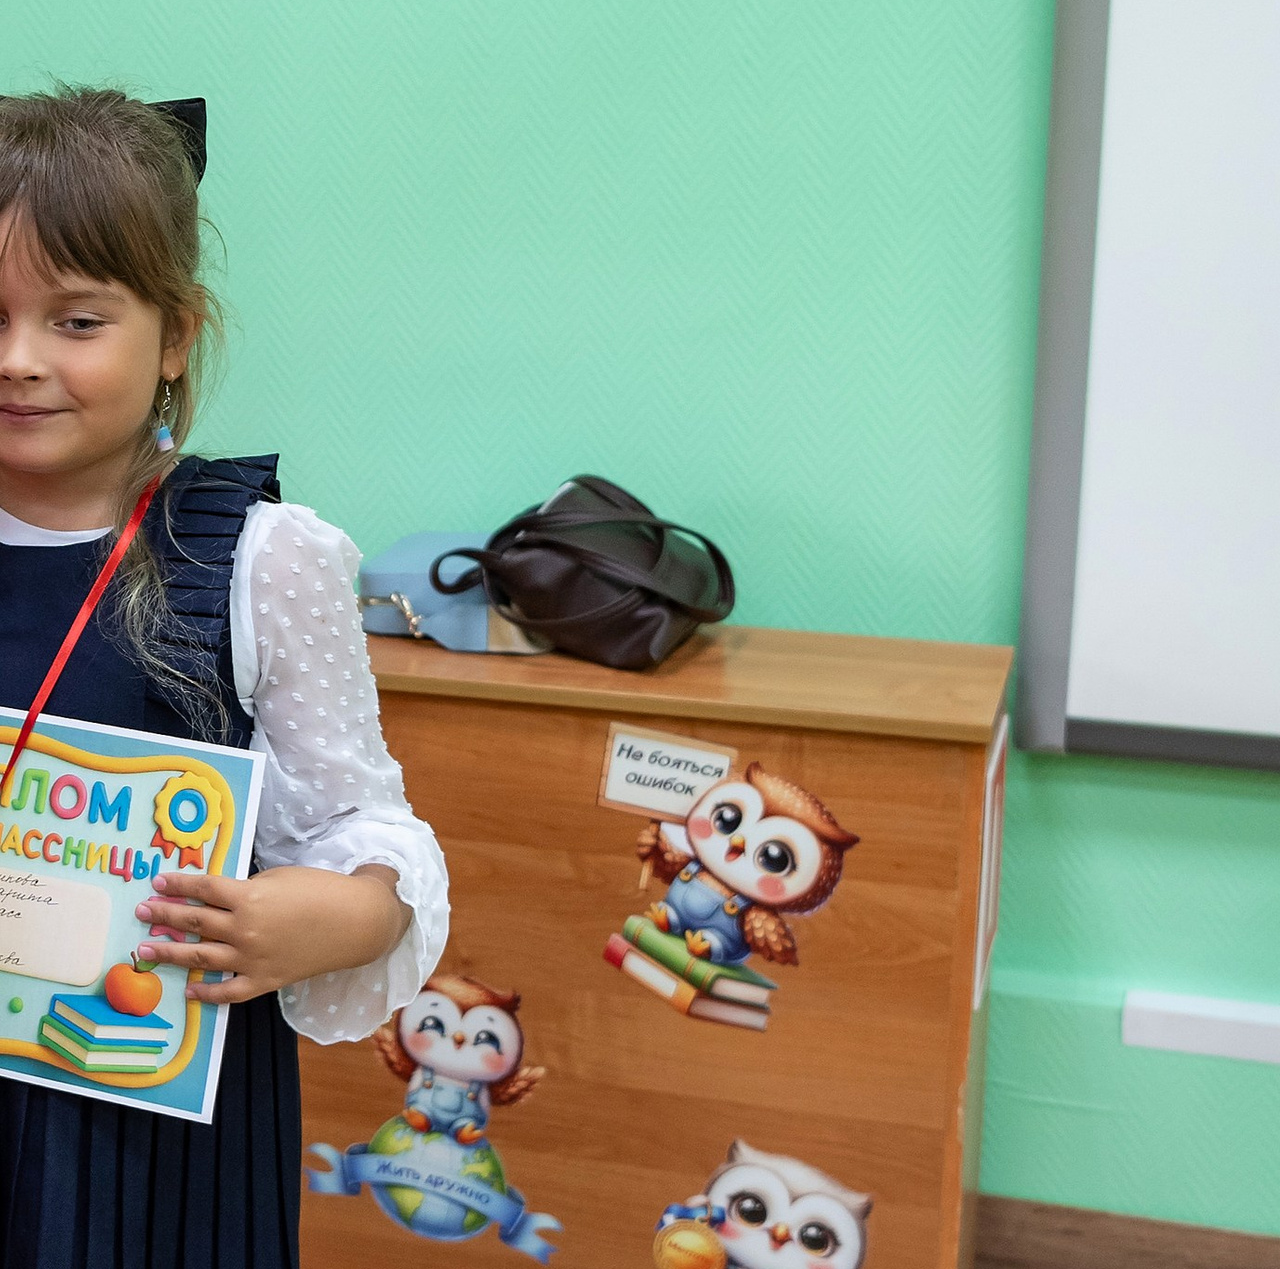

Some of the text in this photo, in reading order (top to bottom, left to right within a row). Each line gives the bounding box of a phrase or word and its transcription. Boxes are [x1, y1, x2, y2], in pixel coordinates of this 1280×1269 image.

[616, 743, 724, 778] Не бояться
[625, 772, 697, 796] ошибок
[376, 1161, 490, 1204] Жить дружно
